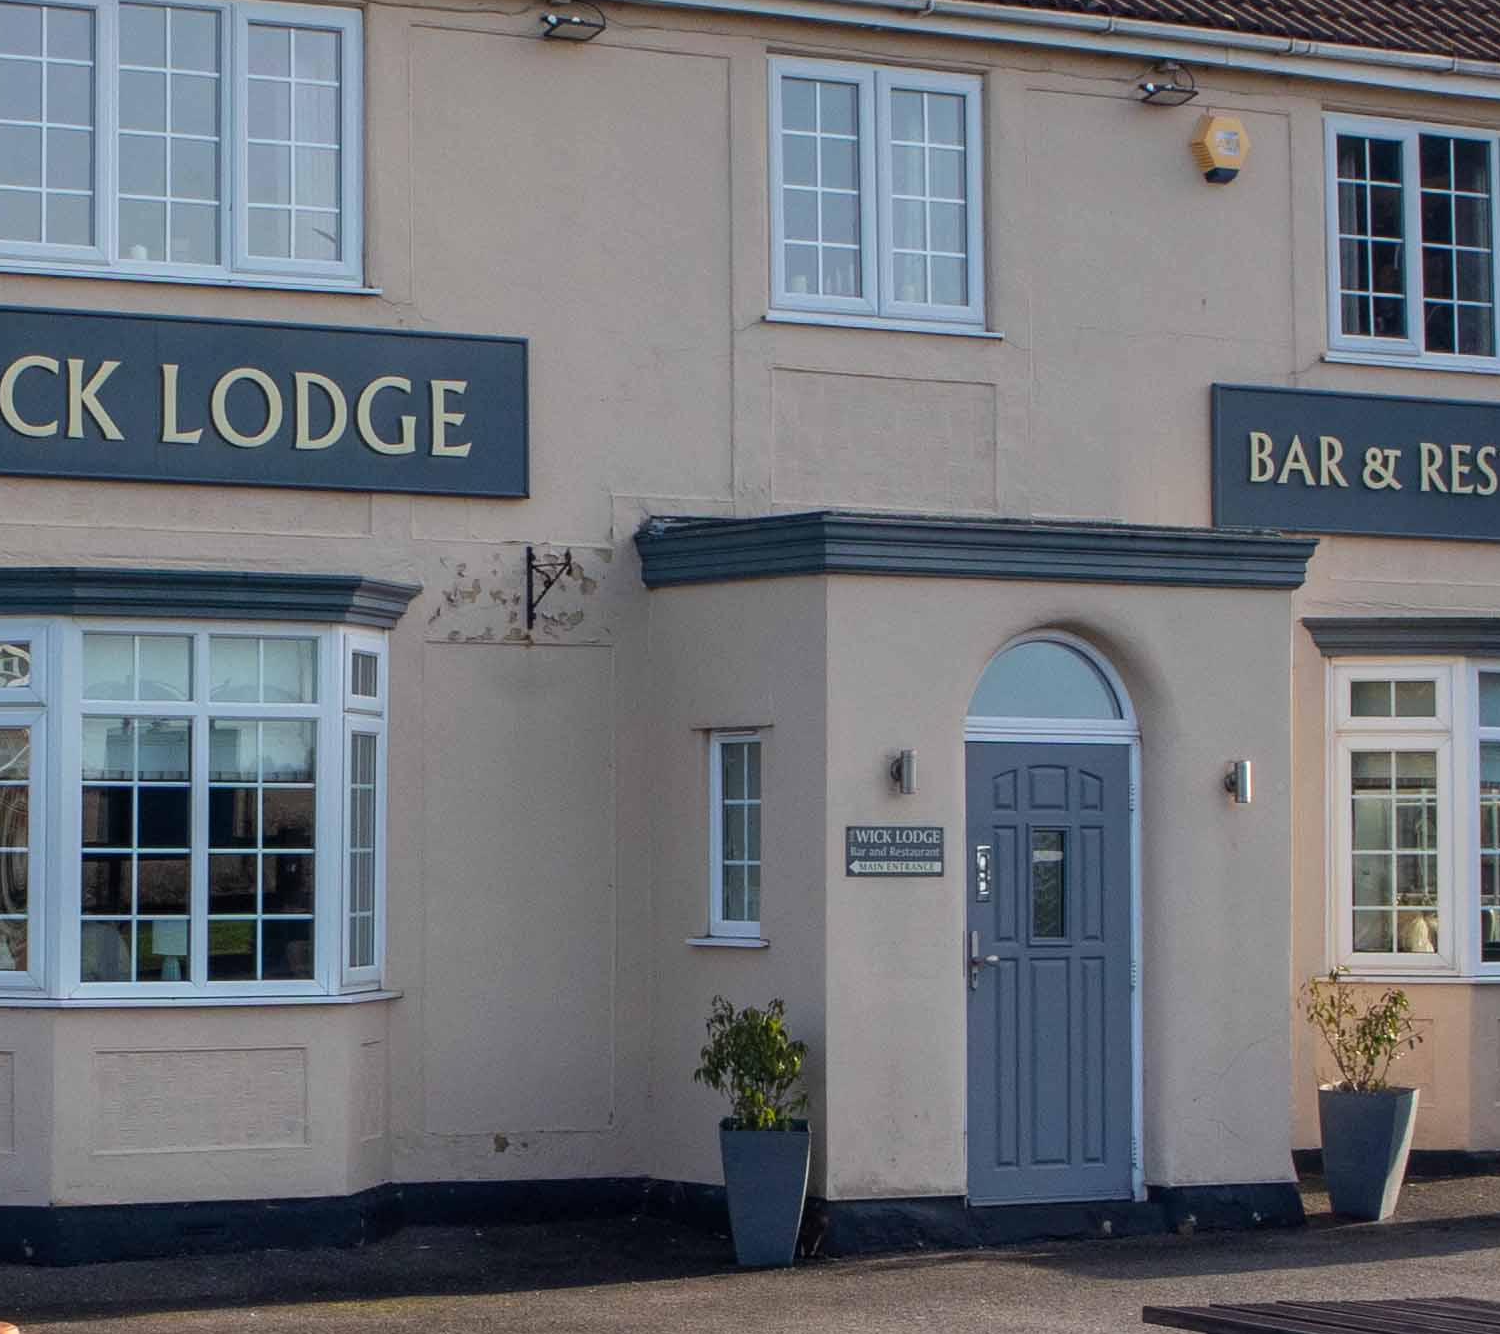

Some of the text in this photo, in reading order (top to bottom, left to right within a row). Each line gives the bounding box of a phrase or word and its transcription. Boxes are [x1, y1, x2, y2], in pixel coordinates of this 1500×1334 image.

[161, 364, 472, 458] LODGE
[1249, 432, 1349, 487] BAR
[1362, 447, 1403, 490] &
[856, 829, 892, 843] WICK
[896, 829, 941, 843] LODGE
[869, 845, 887, 857] and
[889, 845, 940, 857] Restaurant
